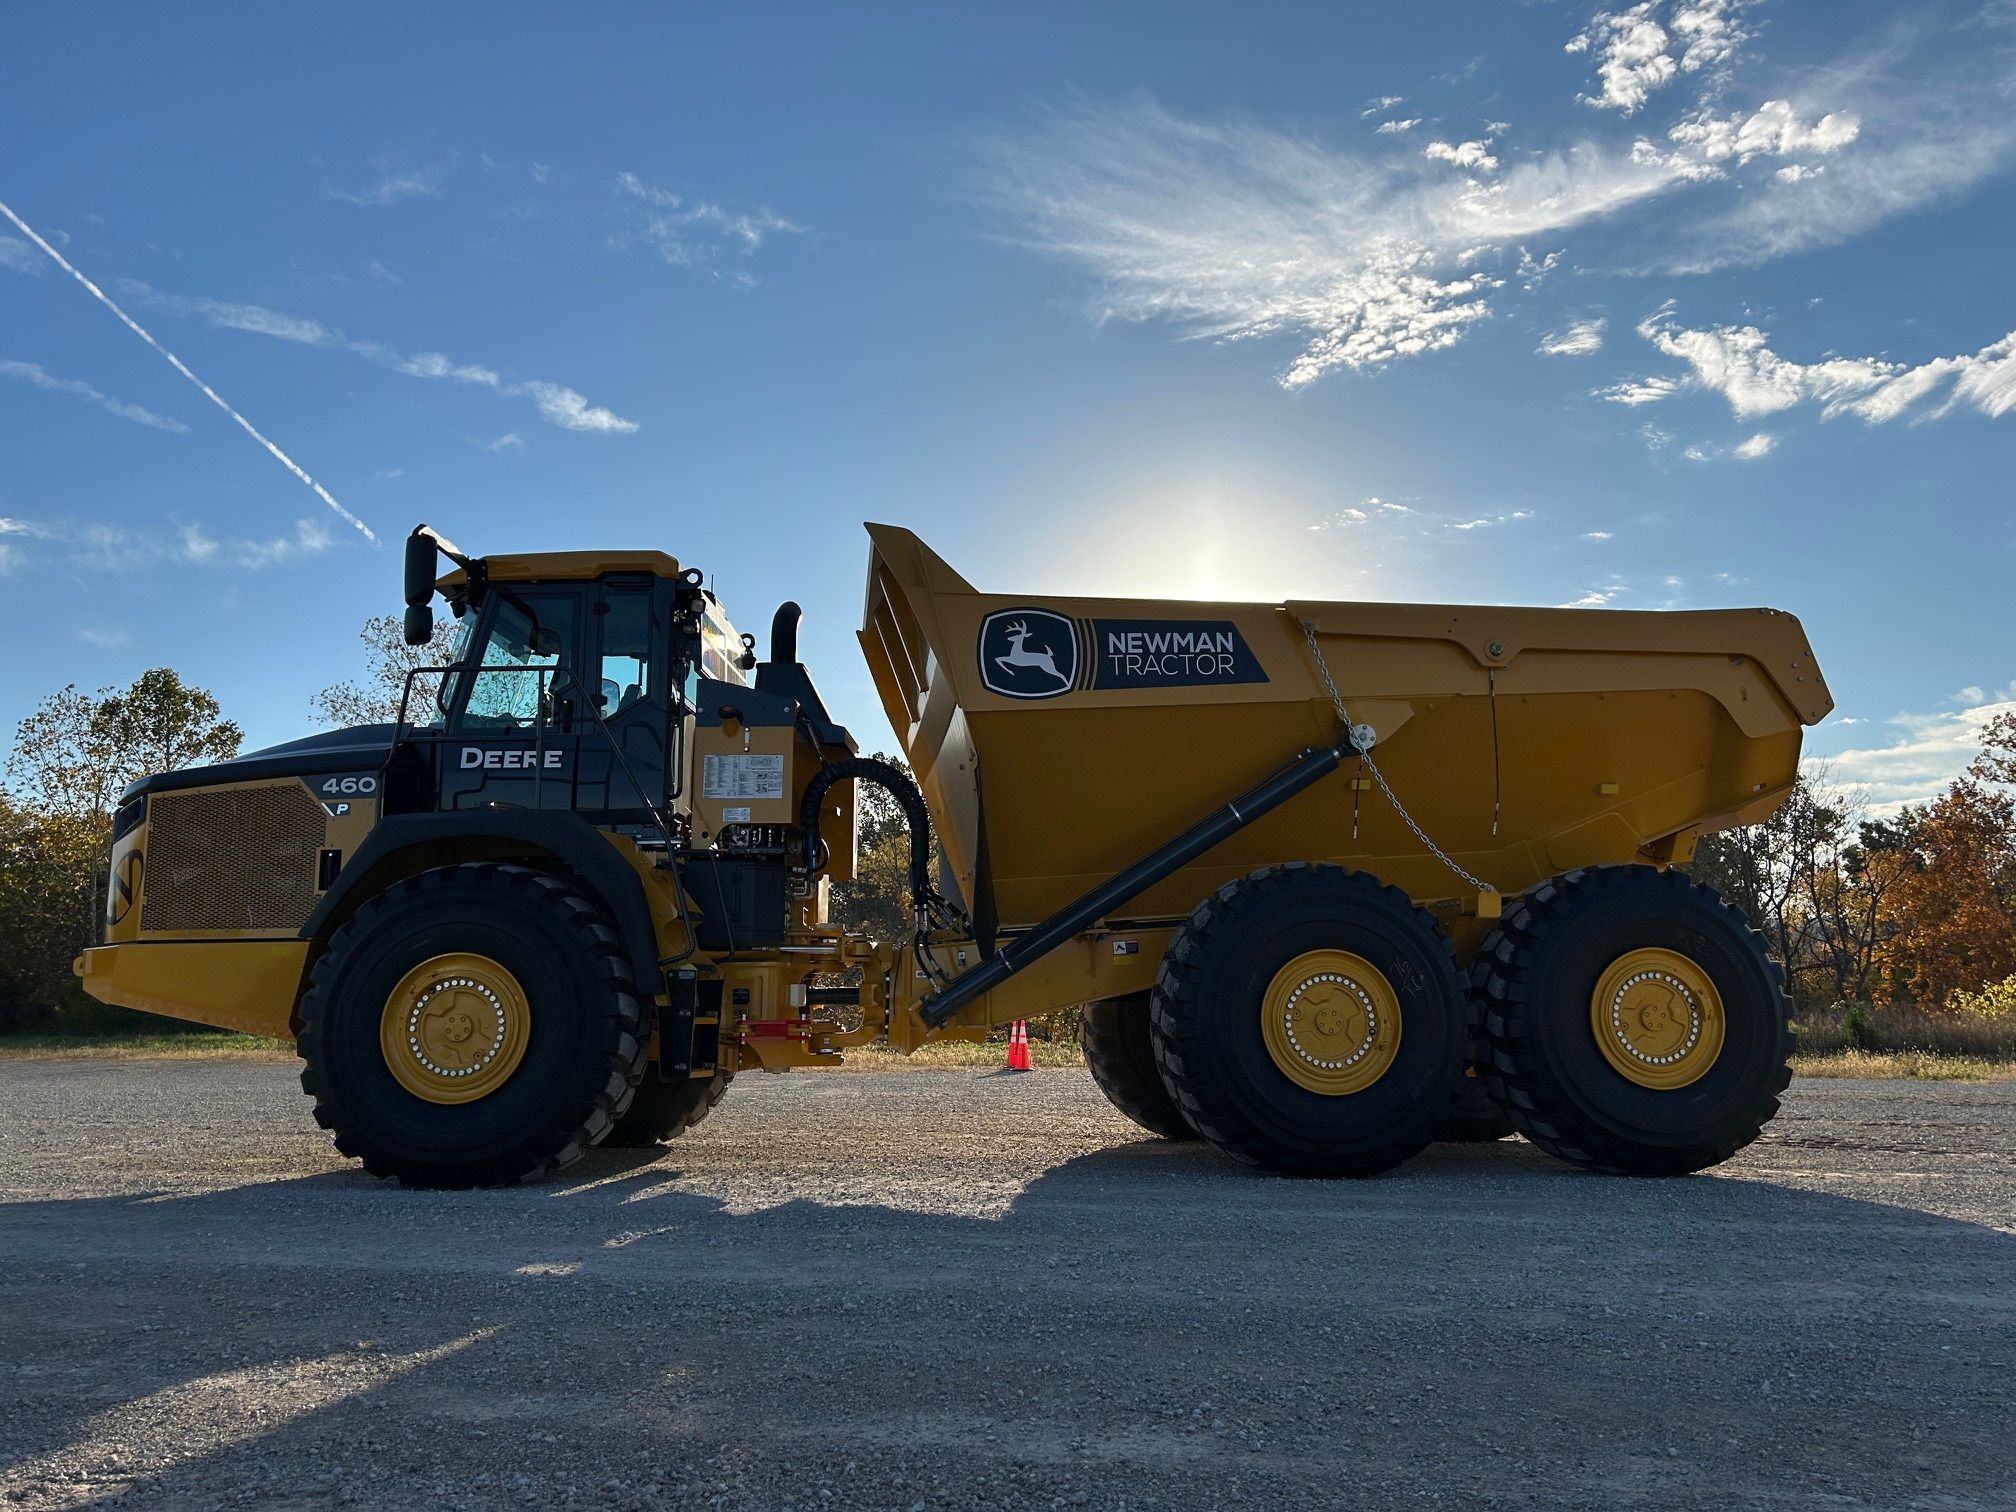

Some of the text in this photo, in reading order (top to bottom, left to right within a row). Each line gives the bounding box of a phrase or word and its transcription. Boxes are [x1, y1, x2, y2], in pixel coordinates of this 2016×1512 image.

[1108, 632, 1233, 653] NEWMAN
[1108, 654, 1235, 675] TRACTOR
[460, 747, 563, 768] DEERE
[322, 776, 377, 794] 460
[336, 803, 349, 815] P
